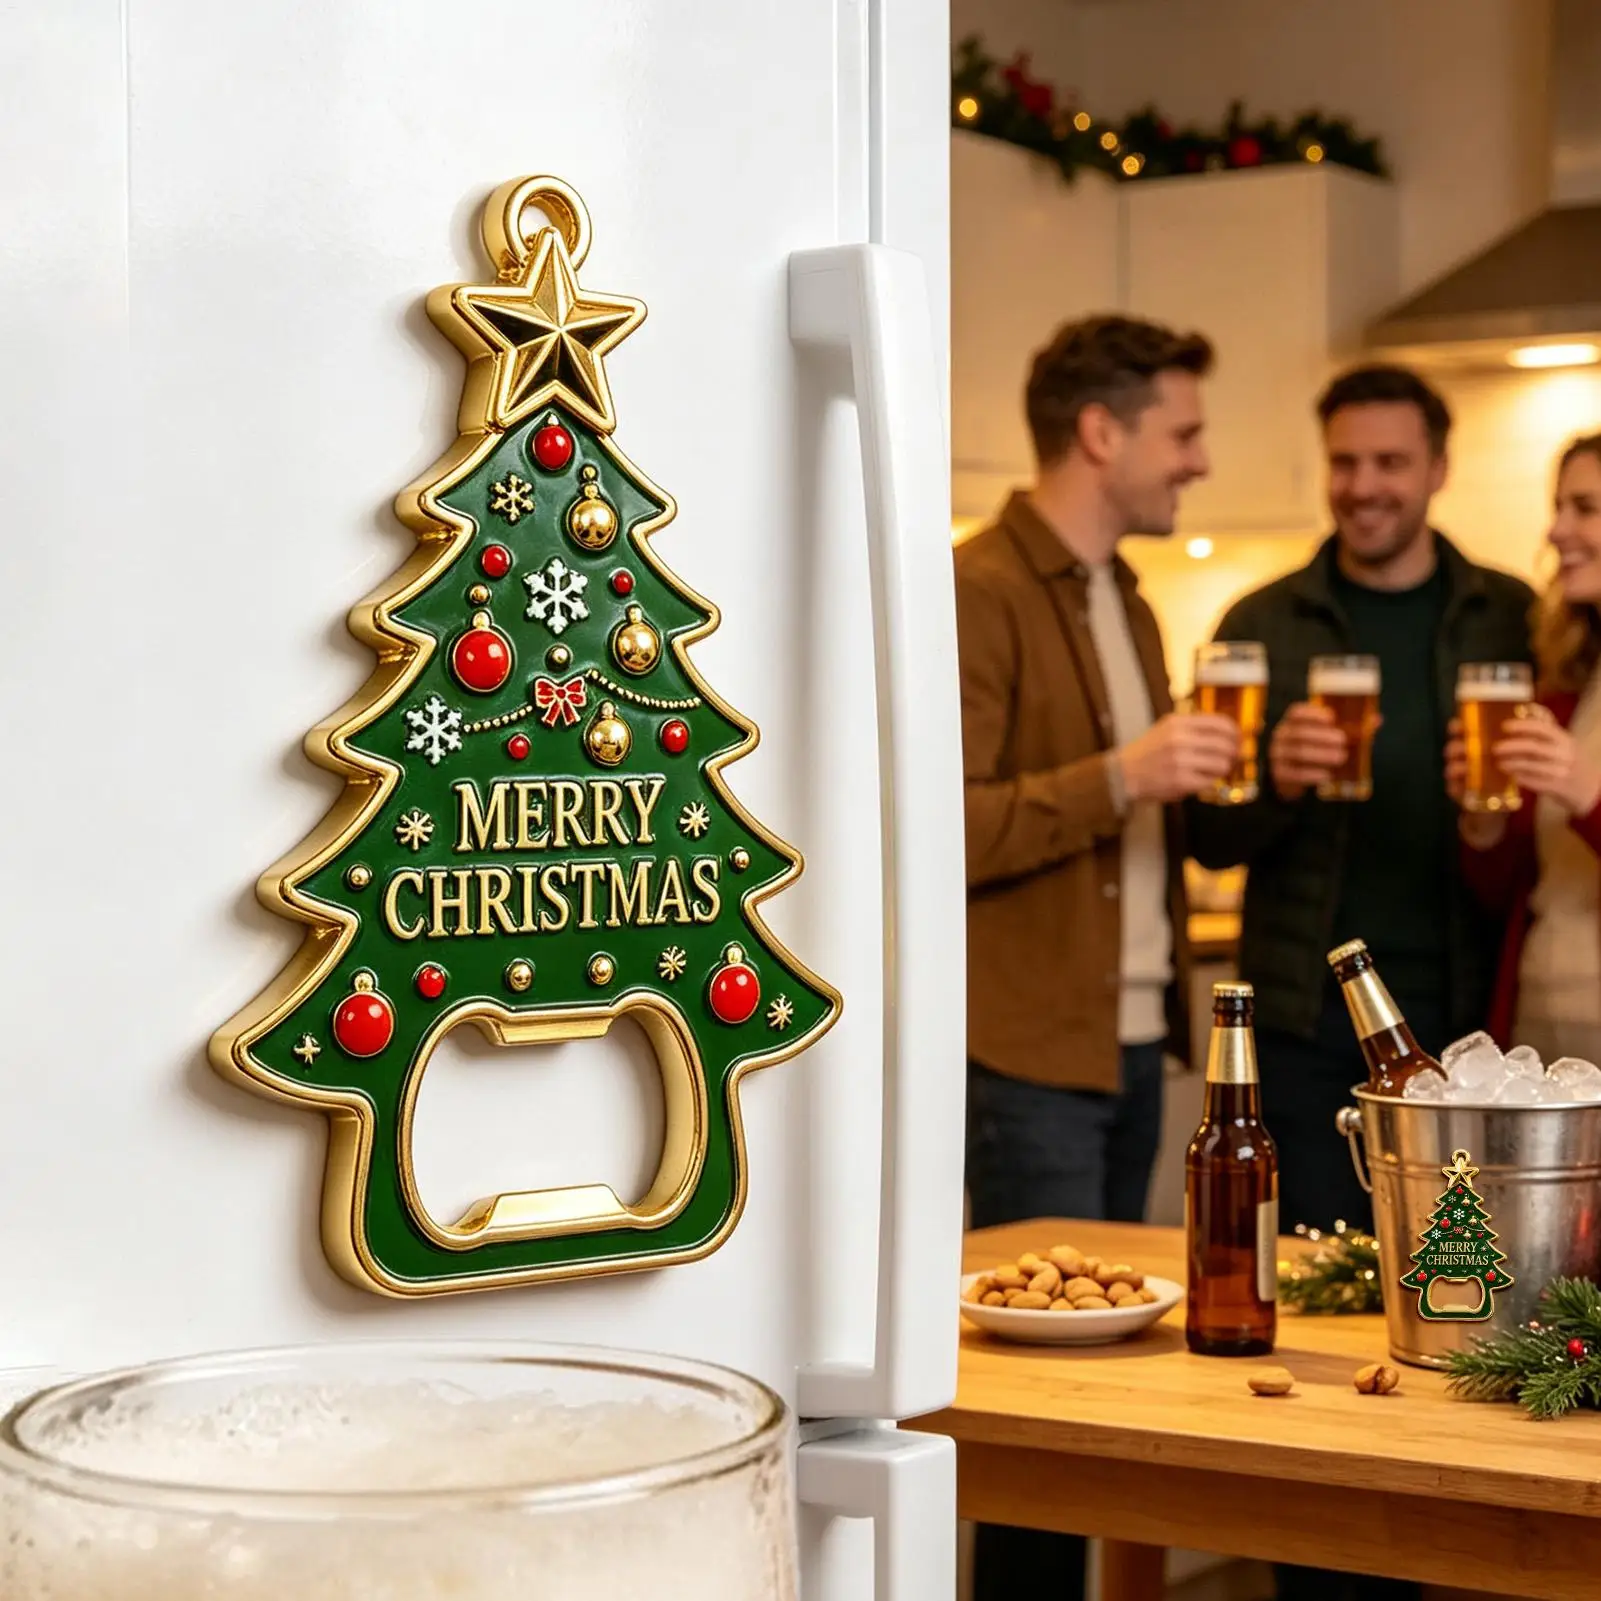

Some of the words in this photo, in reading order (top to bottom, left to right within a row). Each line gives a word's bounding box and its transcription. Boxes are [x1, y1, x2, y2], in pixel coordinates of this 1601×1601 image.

[453, 777, 666, 851] MERRY
[384, 858, 722, 940] CHRISTMAS
[1426, 1255, 1489, 1266] CHRISTMAS
[1439, 1241, 1479, 1253] MERRY
